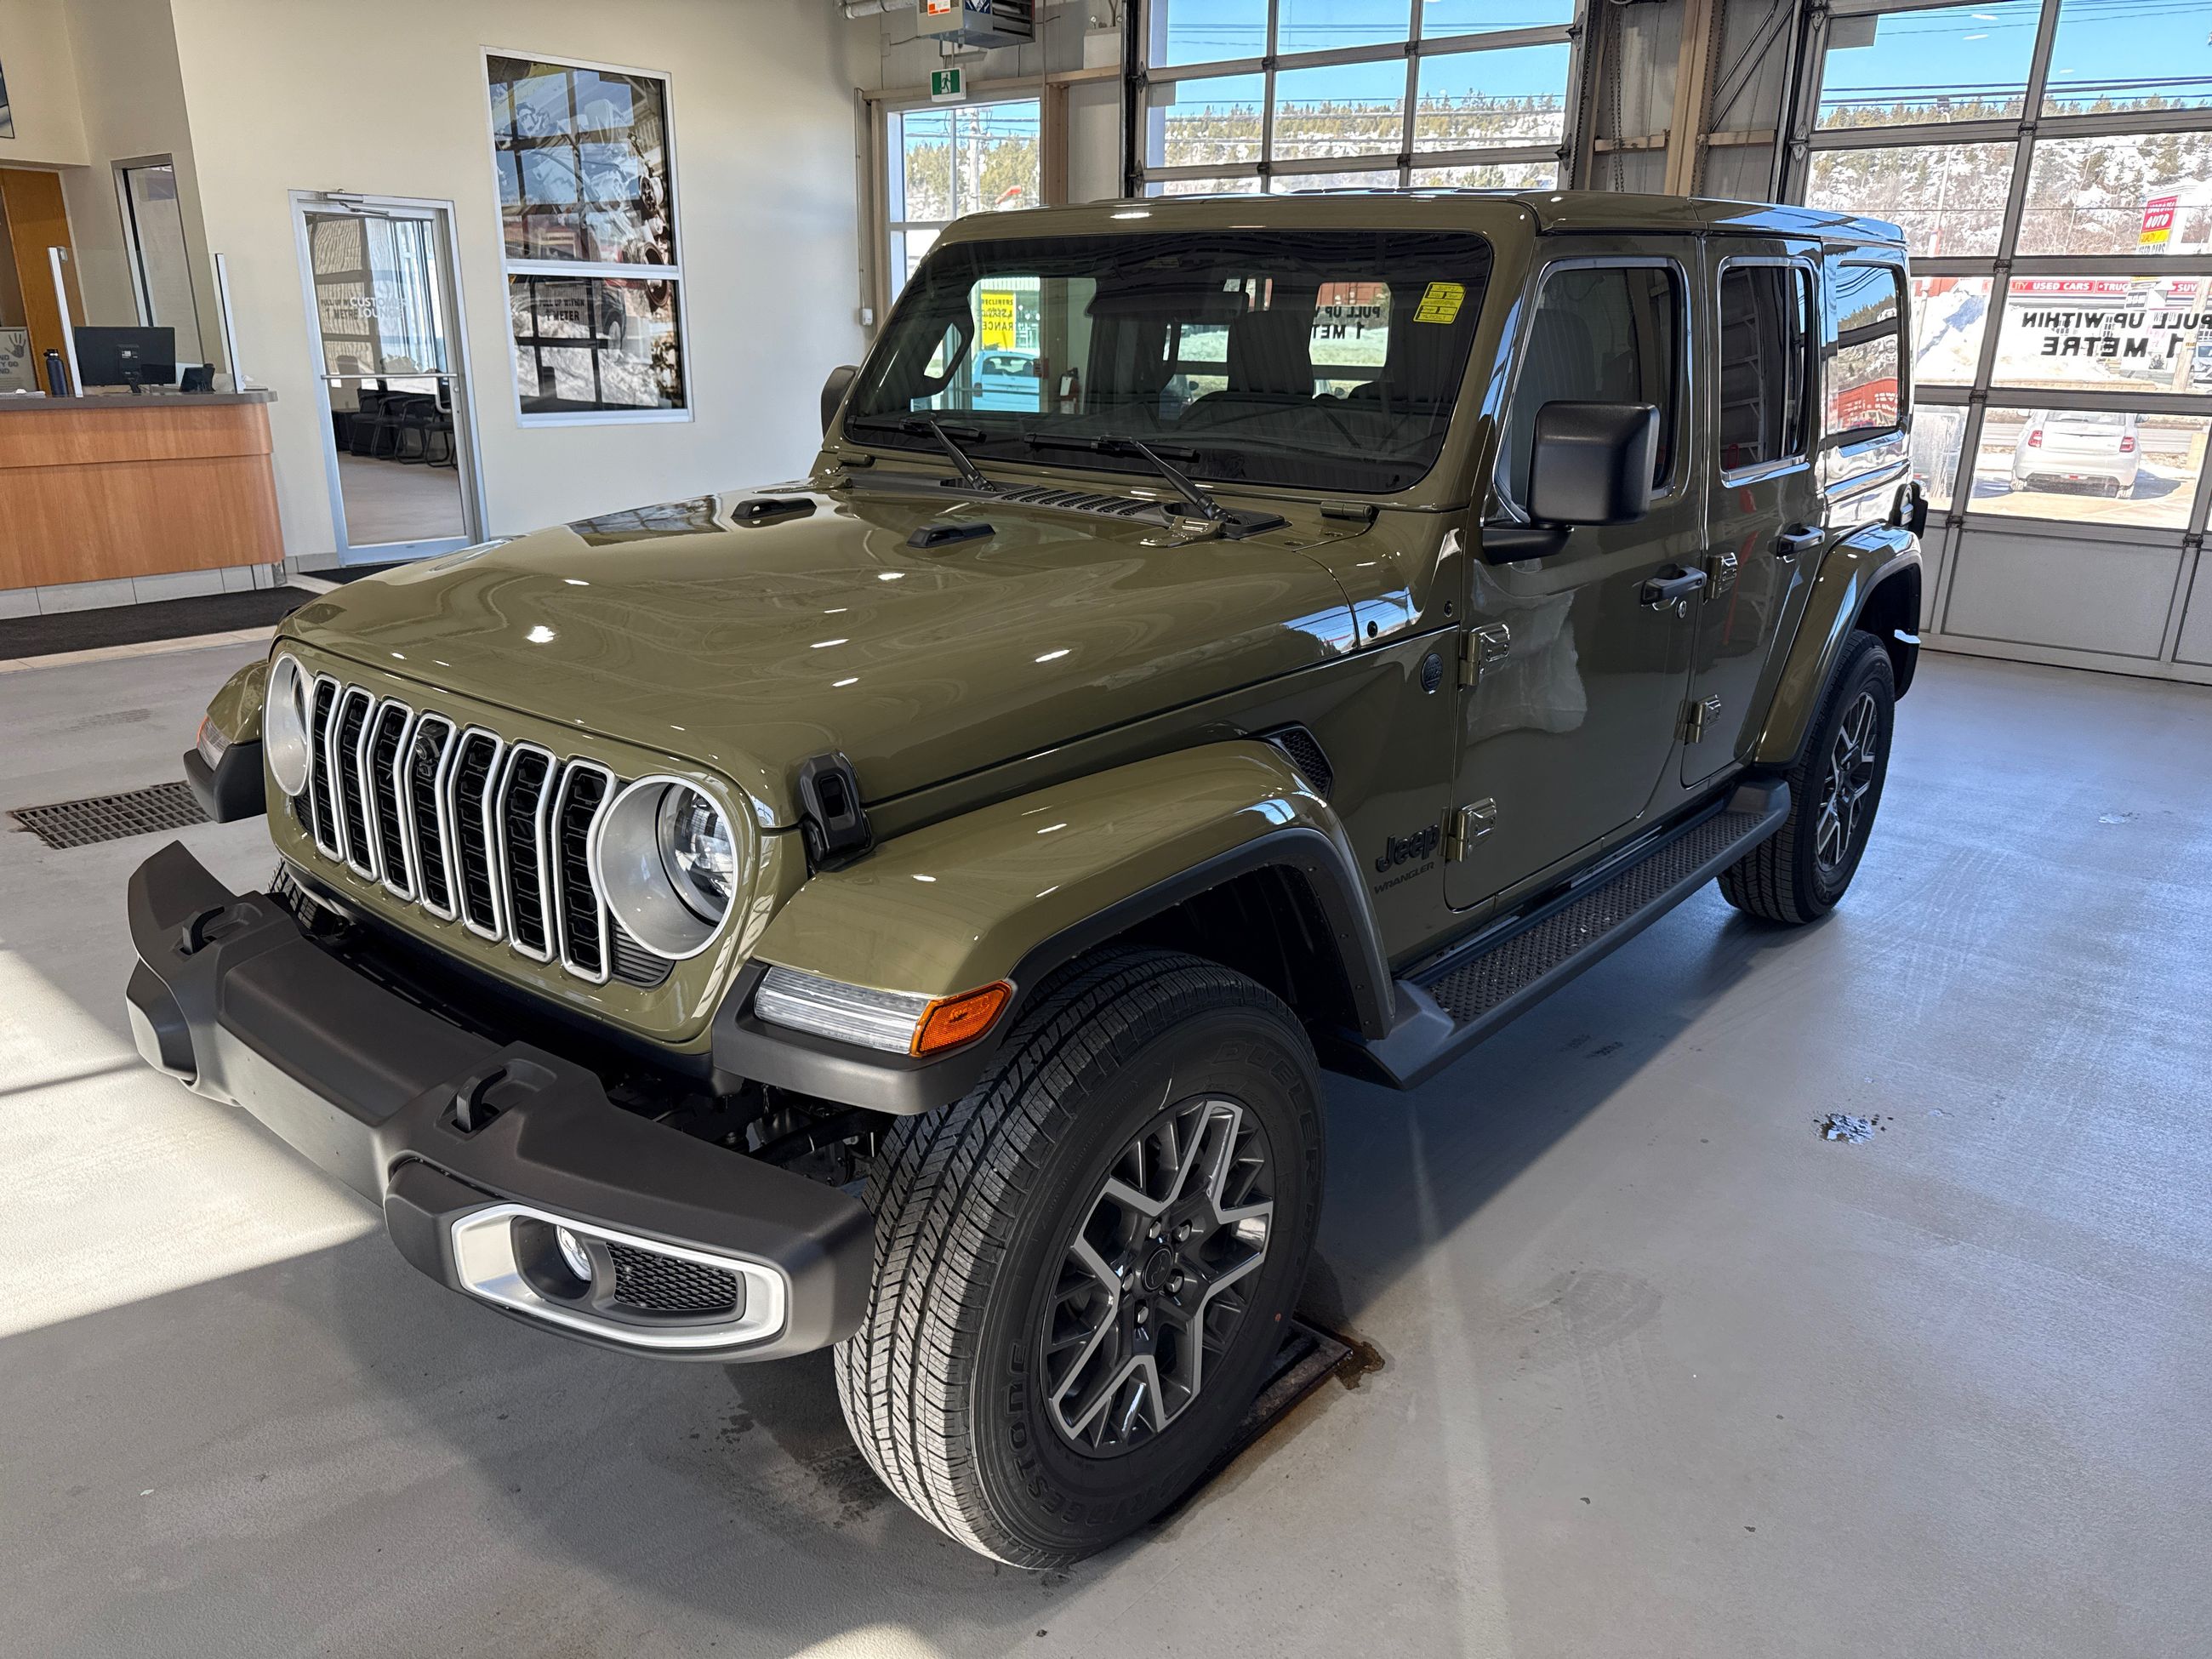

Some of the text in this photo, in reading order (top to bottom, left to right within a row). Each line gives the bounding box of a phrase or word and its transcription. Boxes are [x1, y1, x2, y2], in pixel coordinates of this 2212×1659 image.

[2145, 214, 2170, 228] AUTO
[2103, 282, 2132, 291] TRUC
[350, 297, 407, 306] CUSTOMER
[358, 308, 401, 318] LOUNGE
[1375, 824, 1440, 873] Jeep
[1374, 862, 1434, 894] WRANGLER
[1211, 1040, 1320, 1185] DUELER
[1003, 1343, 1186, 1526] BRIDGESTONE
